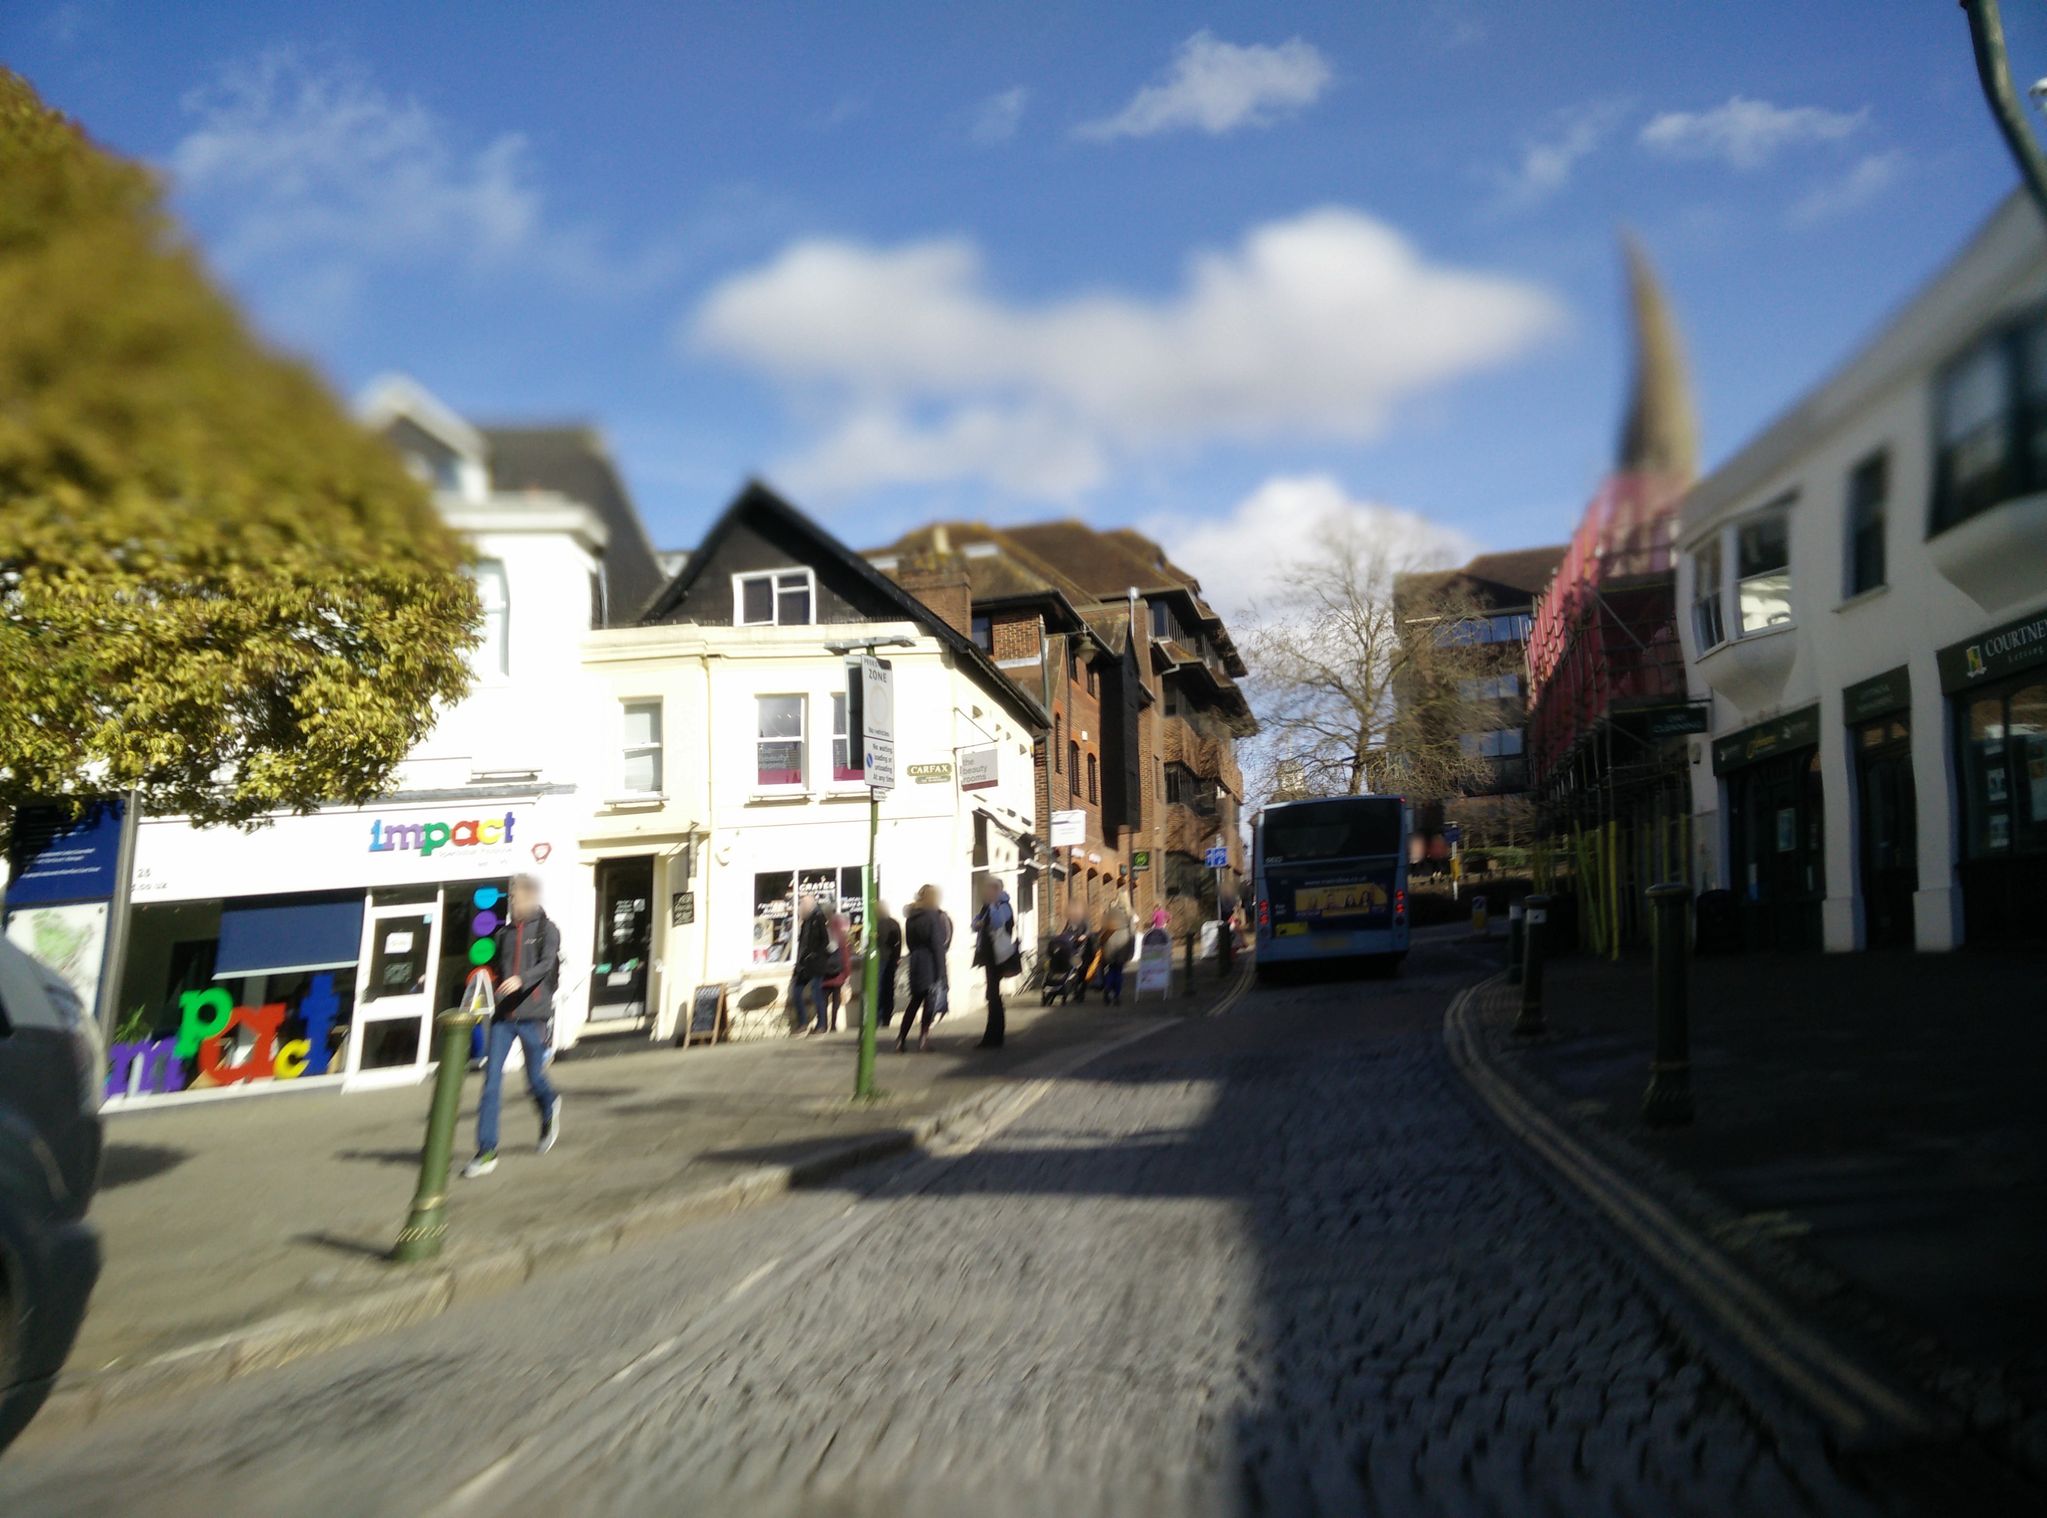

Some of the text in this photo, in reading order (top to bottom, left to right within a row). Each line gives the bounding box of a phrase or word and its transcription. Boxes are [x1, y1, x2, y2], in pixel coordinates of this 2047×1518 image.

[868, 668, 887, 684] ZONE
[910, 764, 948, 775] CARFAX
[963, 765, 987, 775] beauty
[963, 774, 987, 783] rooms
[368, 811, 516, 857] impact
